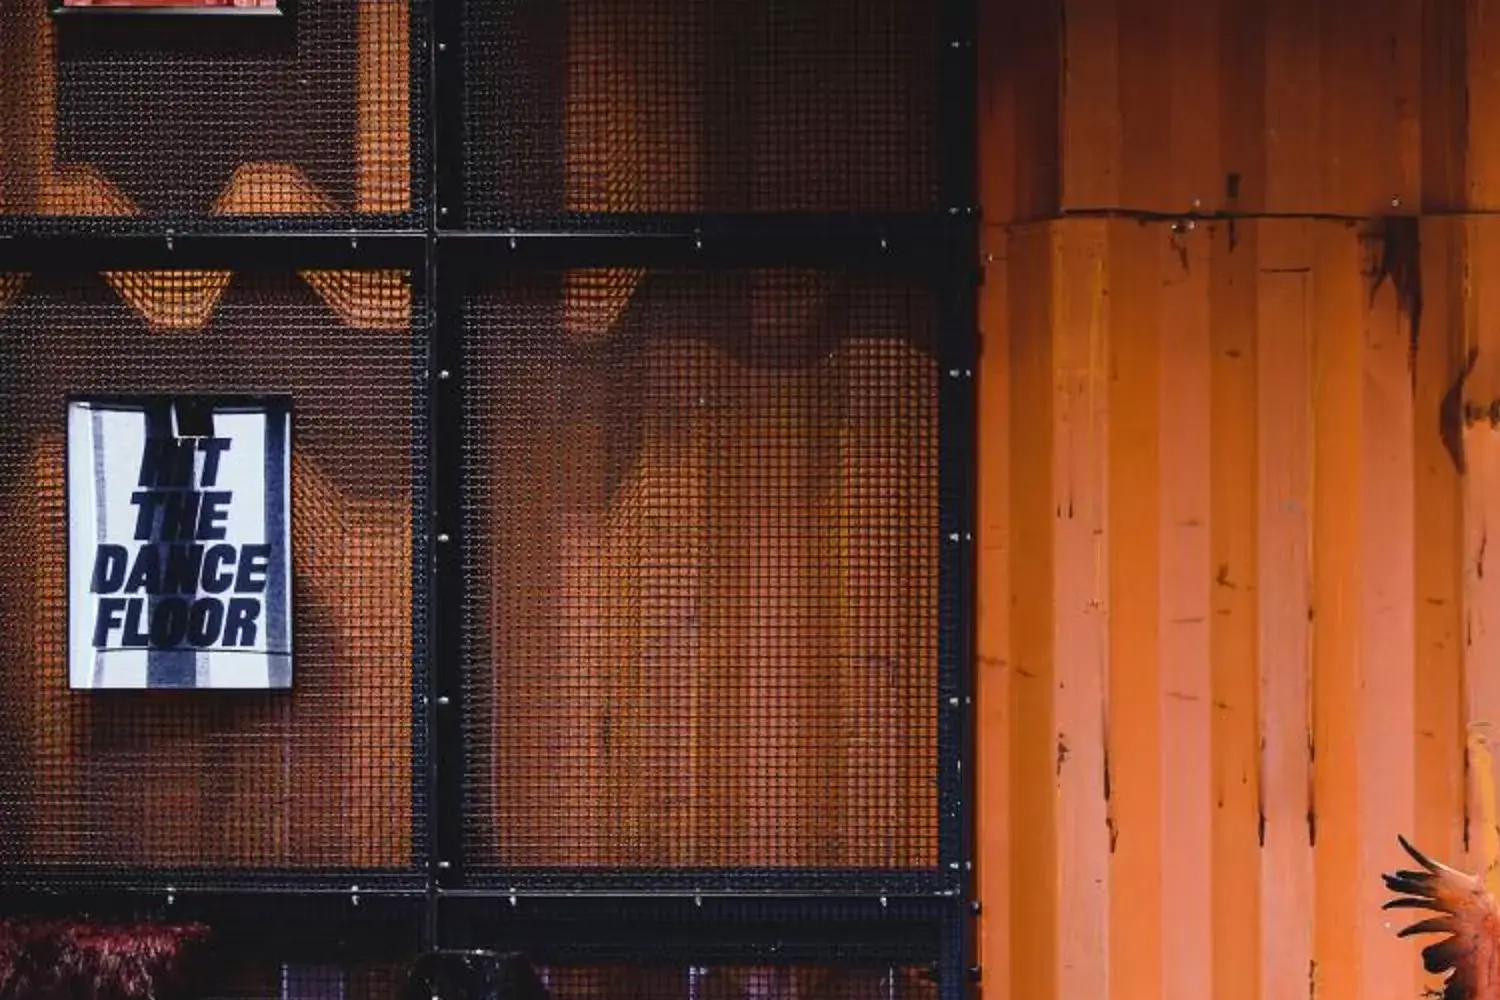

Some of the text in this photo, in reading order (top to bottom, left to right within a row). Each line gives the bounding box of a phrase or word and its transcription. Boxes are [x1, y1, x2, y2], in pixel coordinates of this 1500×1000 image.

[130, 490, 233, 540] THE
[90, 543, 272, 594] DANCE
[92, 597, 260, 647] FLOOR
